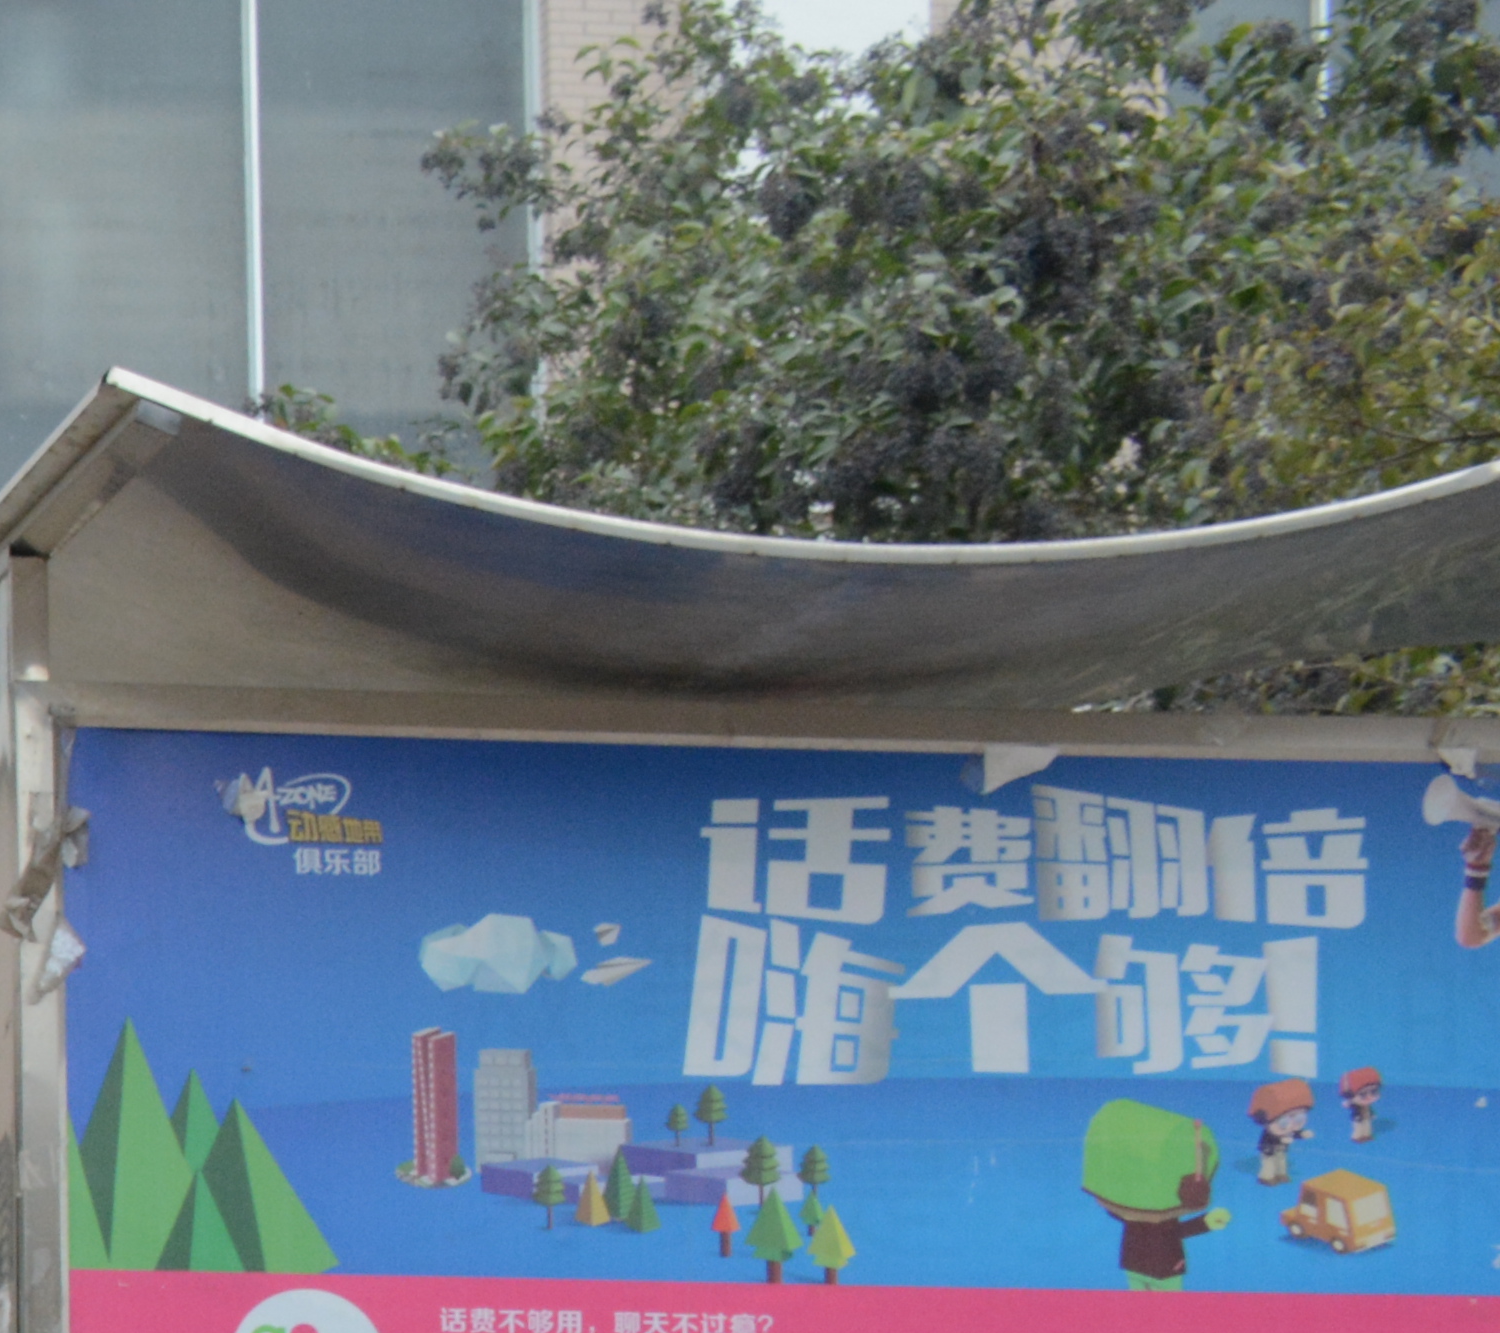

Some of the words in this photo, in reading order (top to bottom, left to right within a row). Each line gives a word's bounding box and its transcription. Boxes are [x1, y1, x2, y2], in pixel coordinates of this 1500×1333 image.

[294, 847, 382, 876] 俱乐部
[701, 784, 1369, 929] 话费翻倍
